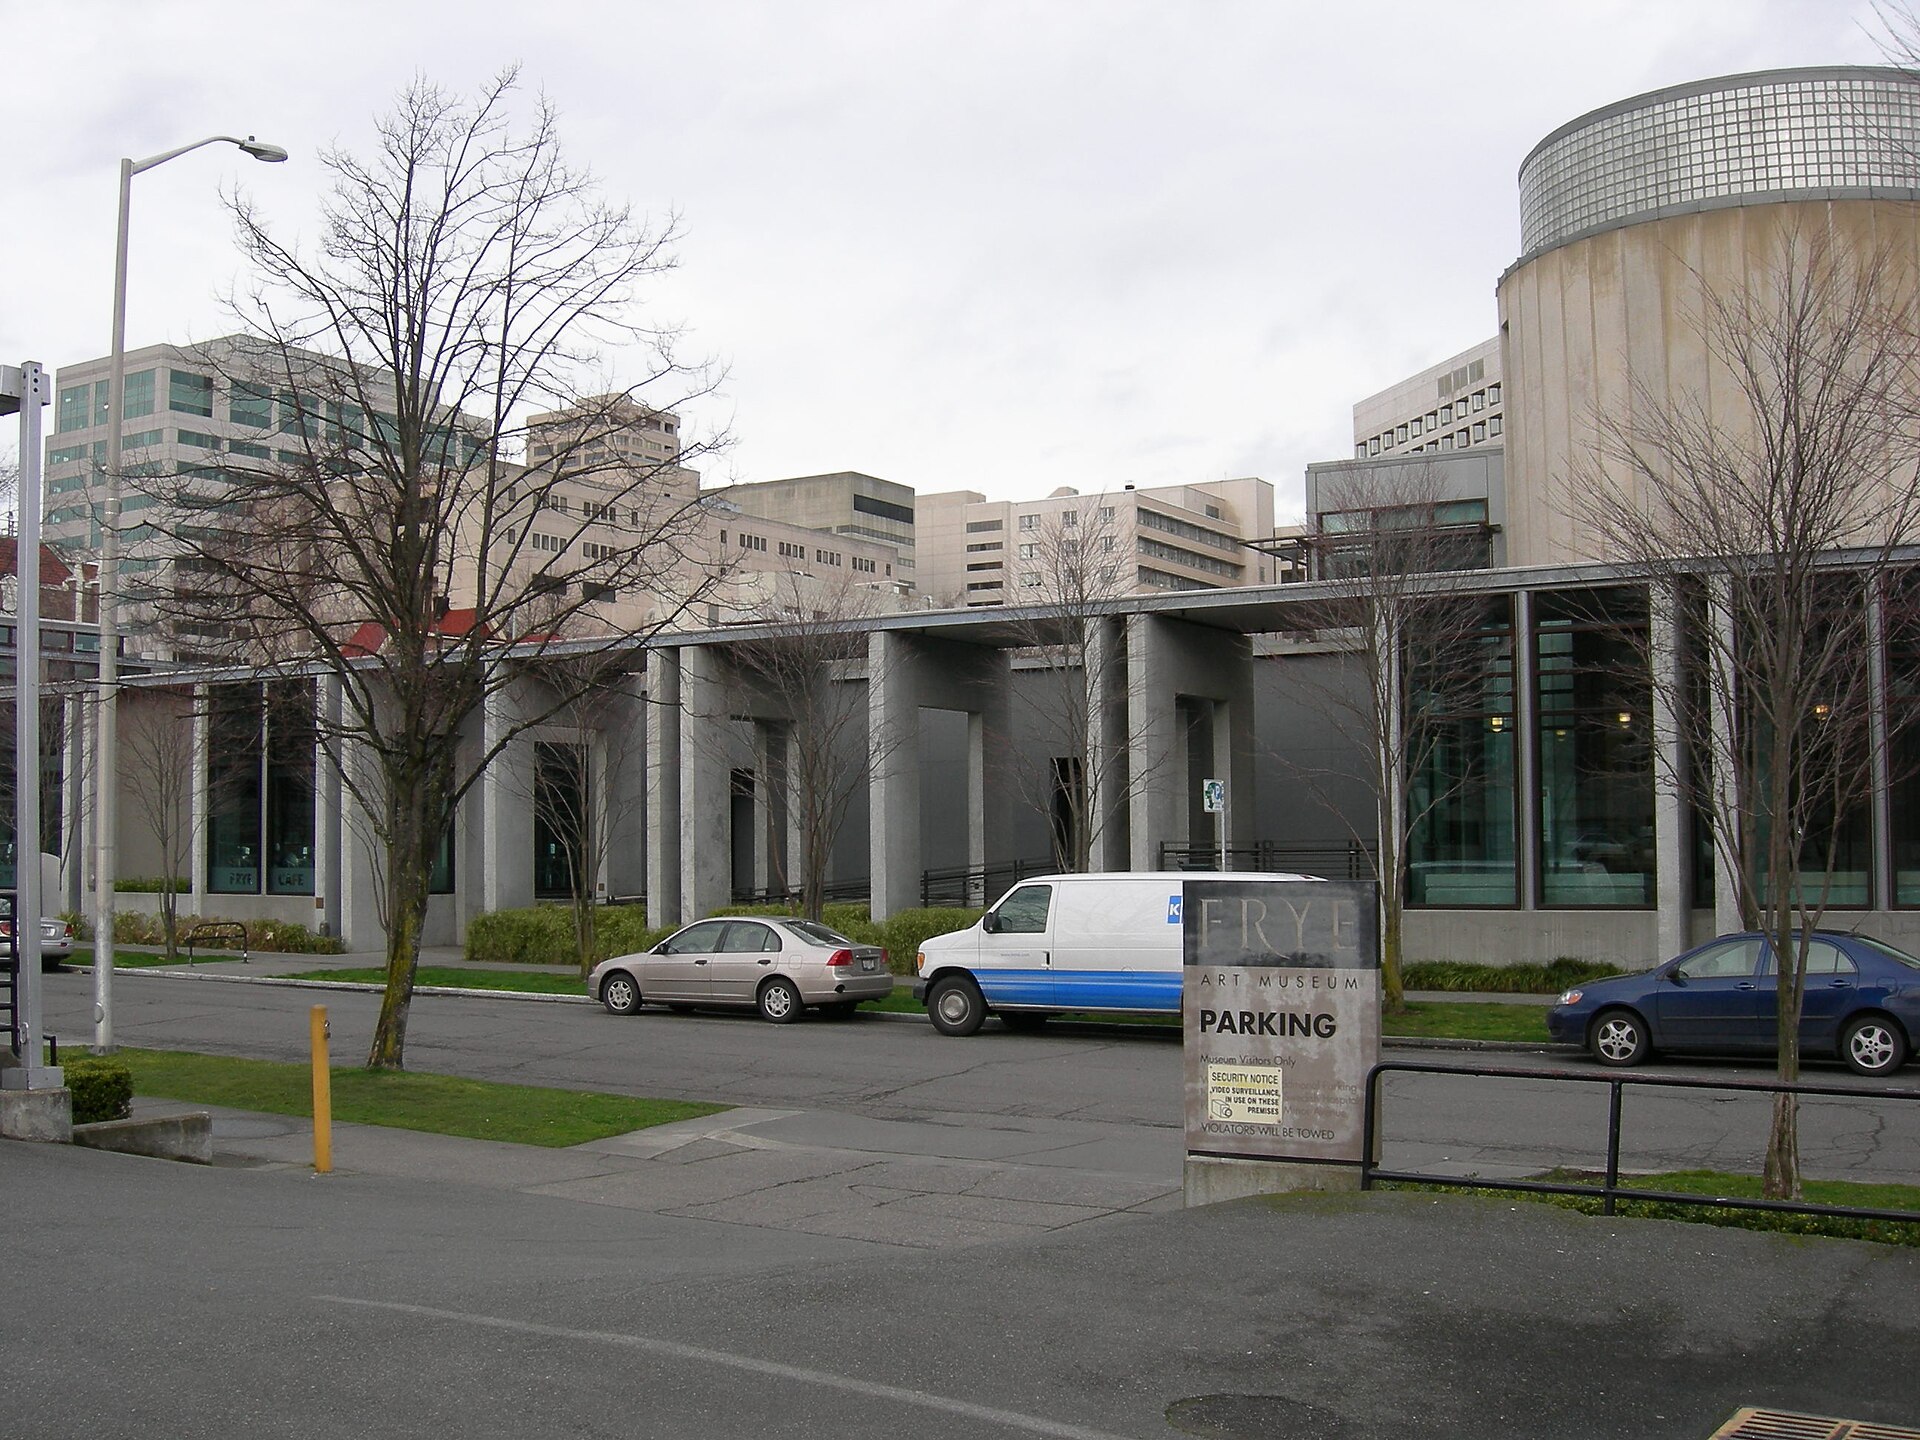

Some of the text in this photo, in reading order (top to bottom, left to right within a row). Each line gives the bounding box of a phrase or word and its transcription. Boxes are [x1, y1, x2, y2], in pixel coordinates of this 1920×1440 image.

[1200, 897, 1358, 960] FRYE
[1200, 973, 1358, 990] ART MUSEUM
[1200, 1009, 1337, 1039] PARKING
[1200, 1054, 1297, 1069] Museum Visitors Only
[1211, 1072, 1249, 1083] SECURITY
[1250, 1074, 1279, 1085] NOTICE
[1211, 1086, 1231, 1094] VIDEO
[1231, 1087, 1279, 1096] SURVEILLANCE
[1234, 1096, 1246, 1104] USE
[1247, 1097, 1257, 1105] ON
[1259, 1098, 1279, 1106] THESE
[1247, 1106, 1279, 1115] PREMISES
[1201, 1122, 1335, 1140] VIOLATORS WILL BE TOWED
